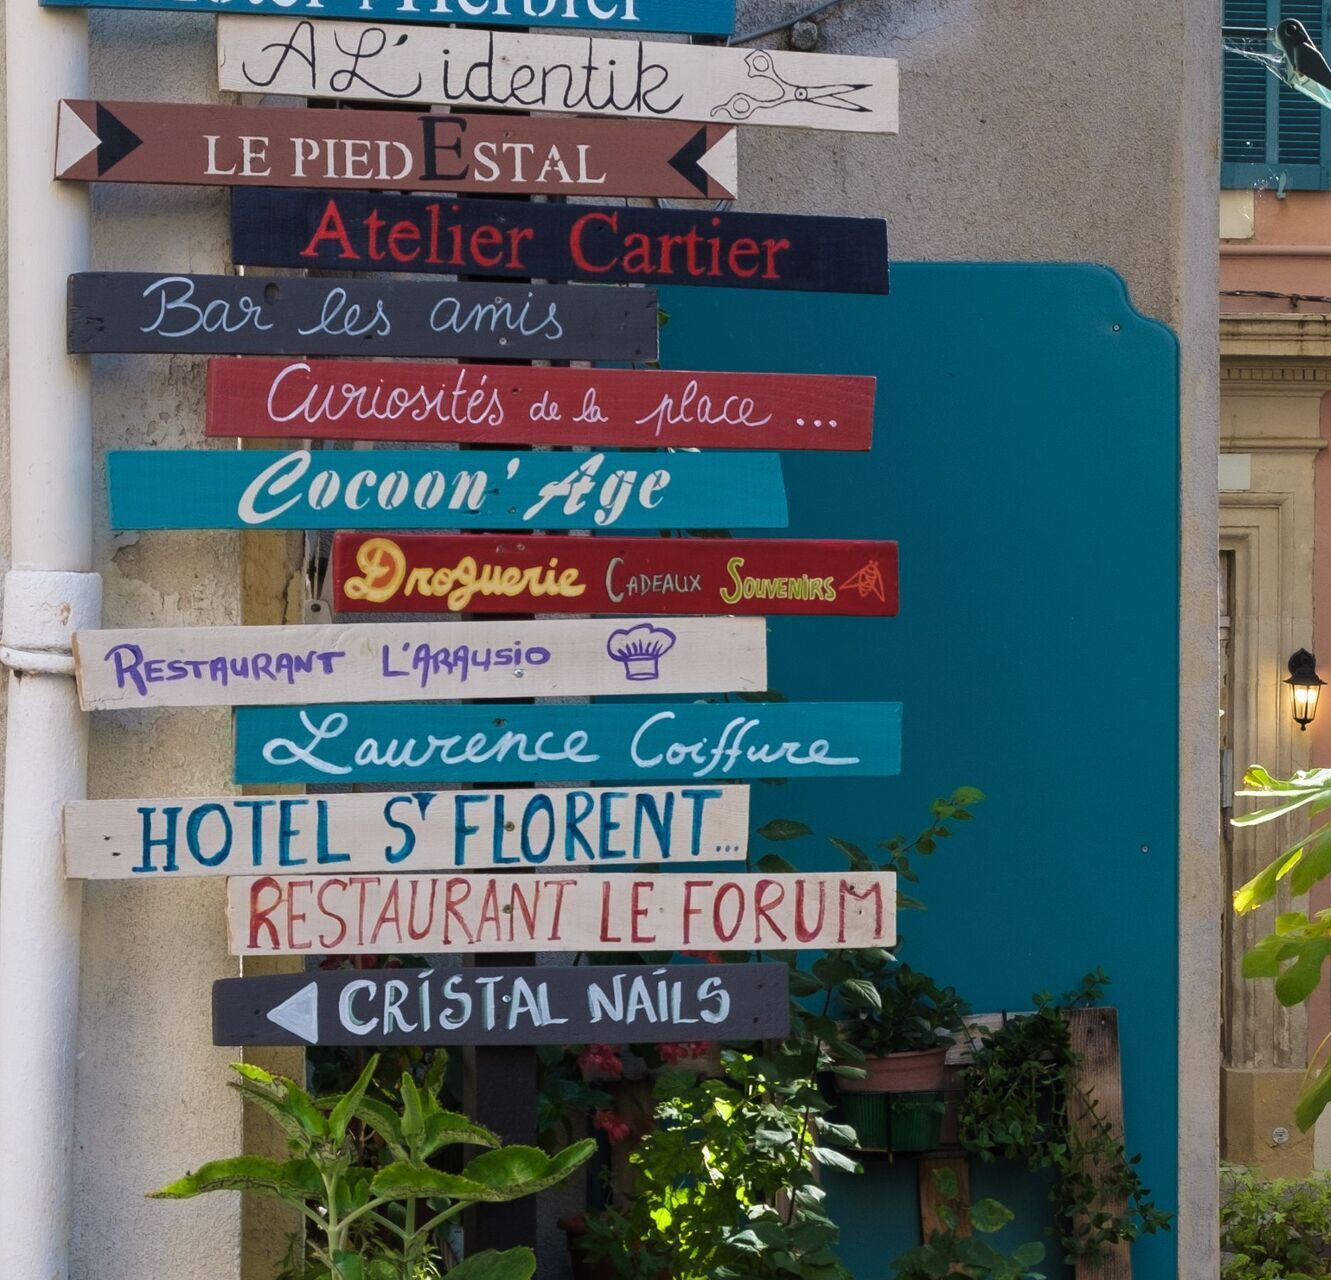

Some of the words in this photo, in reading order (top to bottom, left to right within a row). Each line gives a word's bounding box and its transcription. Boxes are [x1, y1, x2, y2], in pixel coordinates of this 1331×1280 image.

[203, 134, 269, 177] LE
[290, 115, 607, 186] PIEDESTAL
[300, 199, 534, 269] Atelier
[570, 212, 791, 281] Cartier
[143, 277, 273, 338] Bar
[299, 286, 391, 335] les
[431, 296, 564, 341] amis
[266, 363, 505, 426] Curiosités
[529, 392, 563, 423] de
[573, 392, 610, 424] la
[635, 381, 774, 433] place
[343, 539, 586, 613] Droguerie
[263, 711, 598, 775] Laurence
[630, 712, 860, 776] Coiffure
[131, 800, 352, 873] HOTEL
[248, 877, 578, 949] RESTAURANT
[600, 882, 655, 946] LE
[682, 880, 885, 946] FORUM
